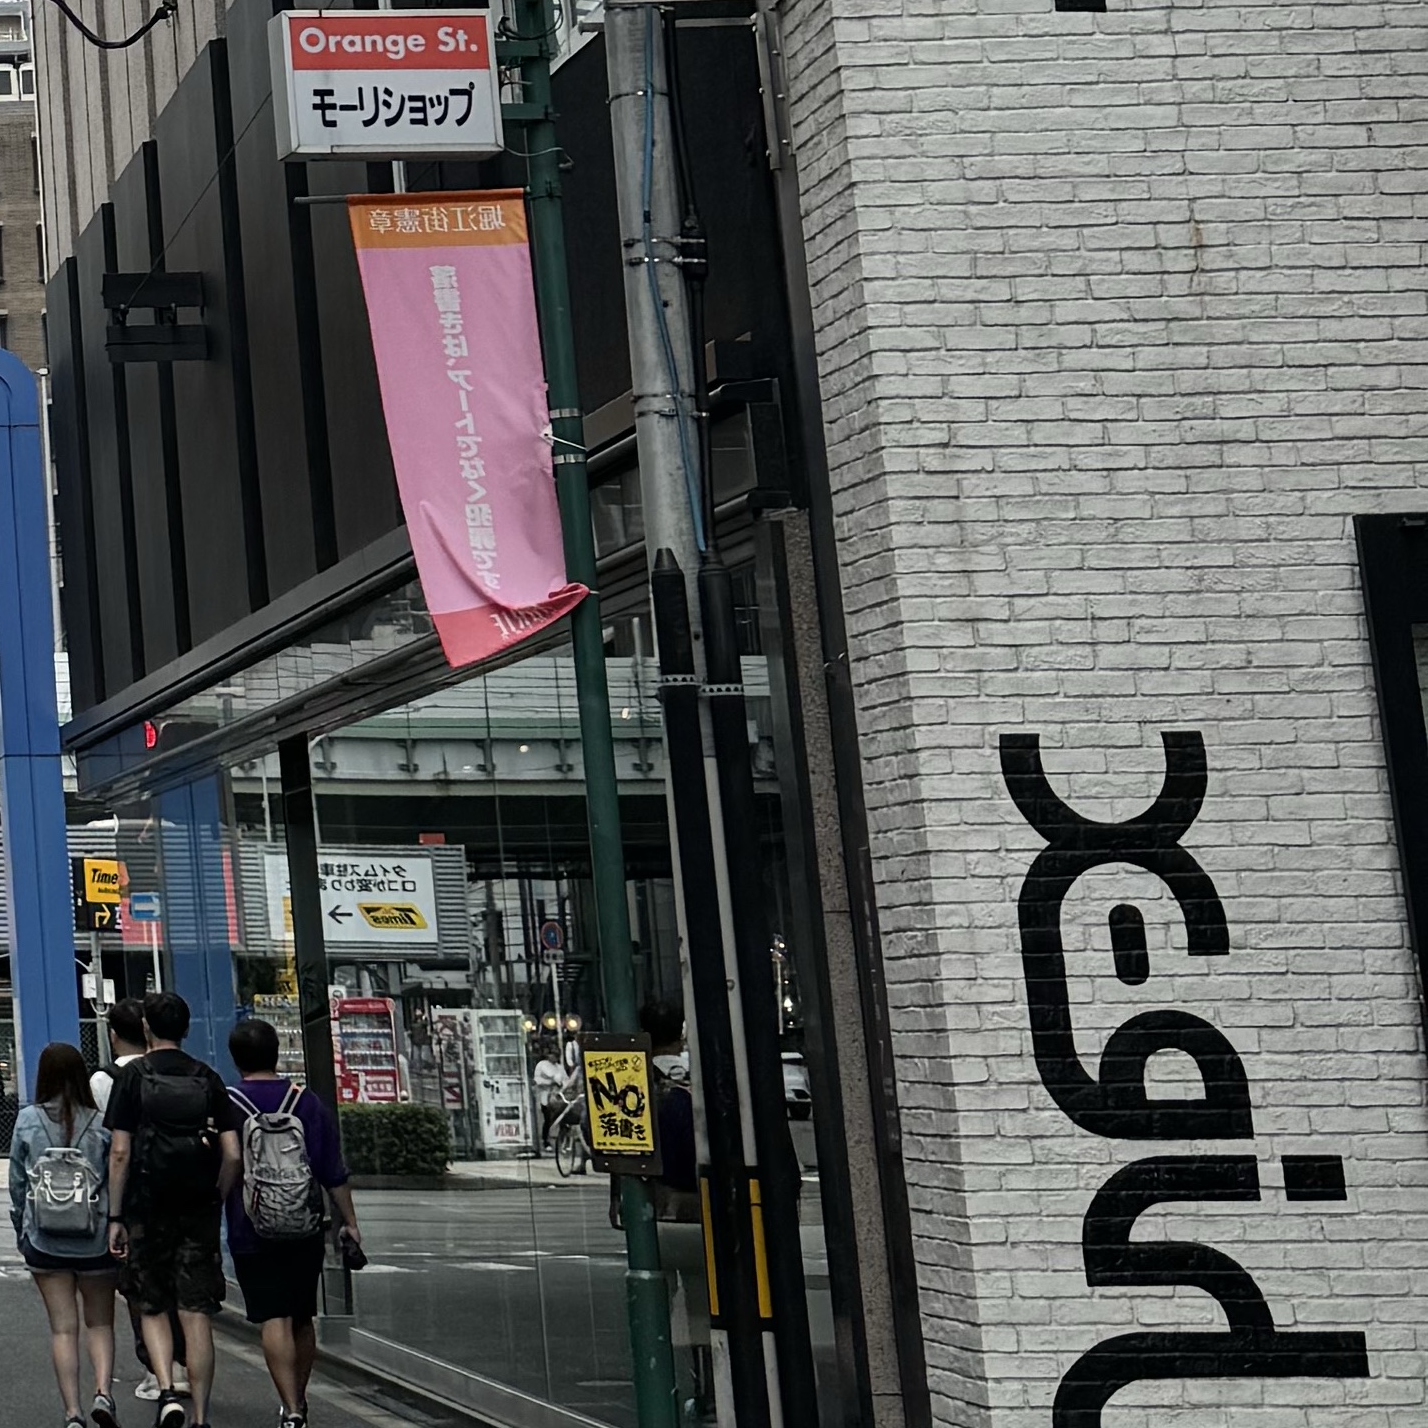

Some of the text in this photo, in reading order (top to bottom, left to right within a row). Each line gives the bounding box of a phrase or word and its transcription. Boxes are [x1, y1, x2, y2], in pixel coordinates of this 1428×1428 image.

[299, 26, 479, 58] Orange St.
[312, 82, 476, 128] モーリショップ
[91, 868, 119, 884] Time
